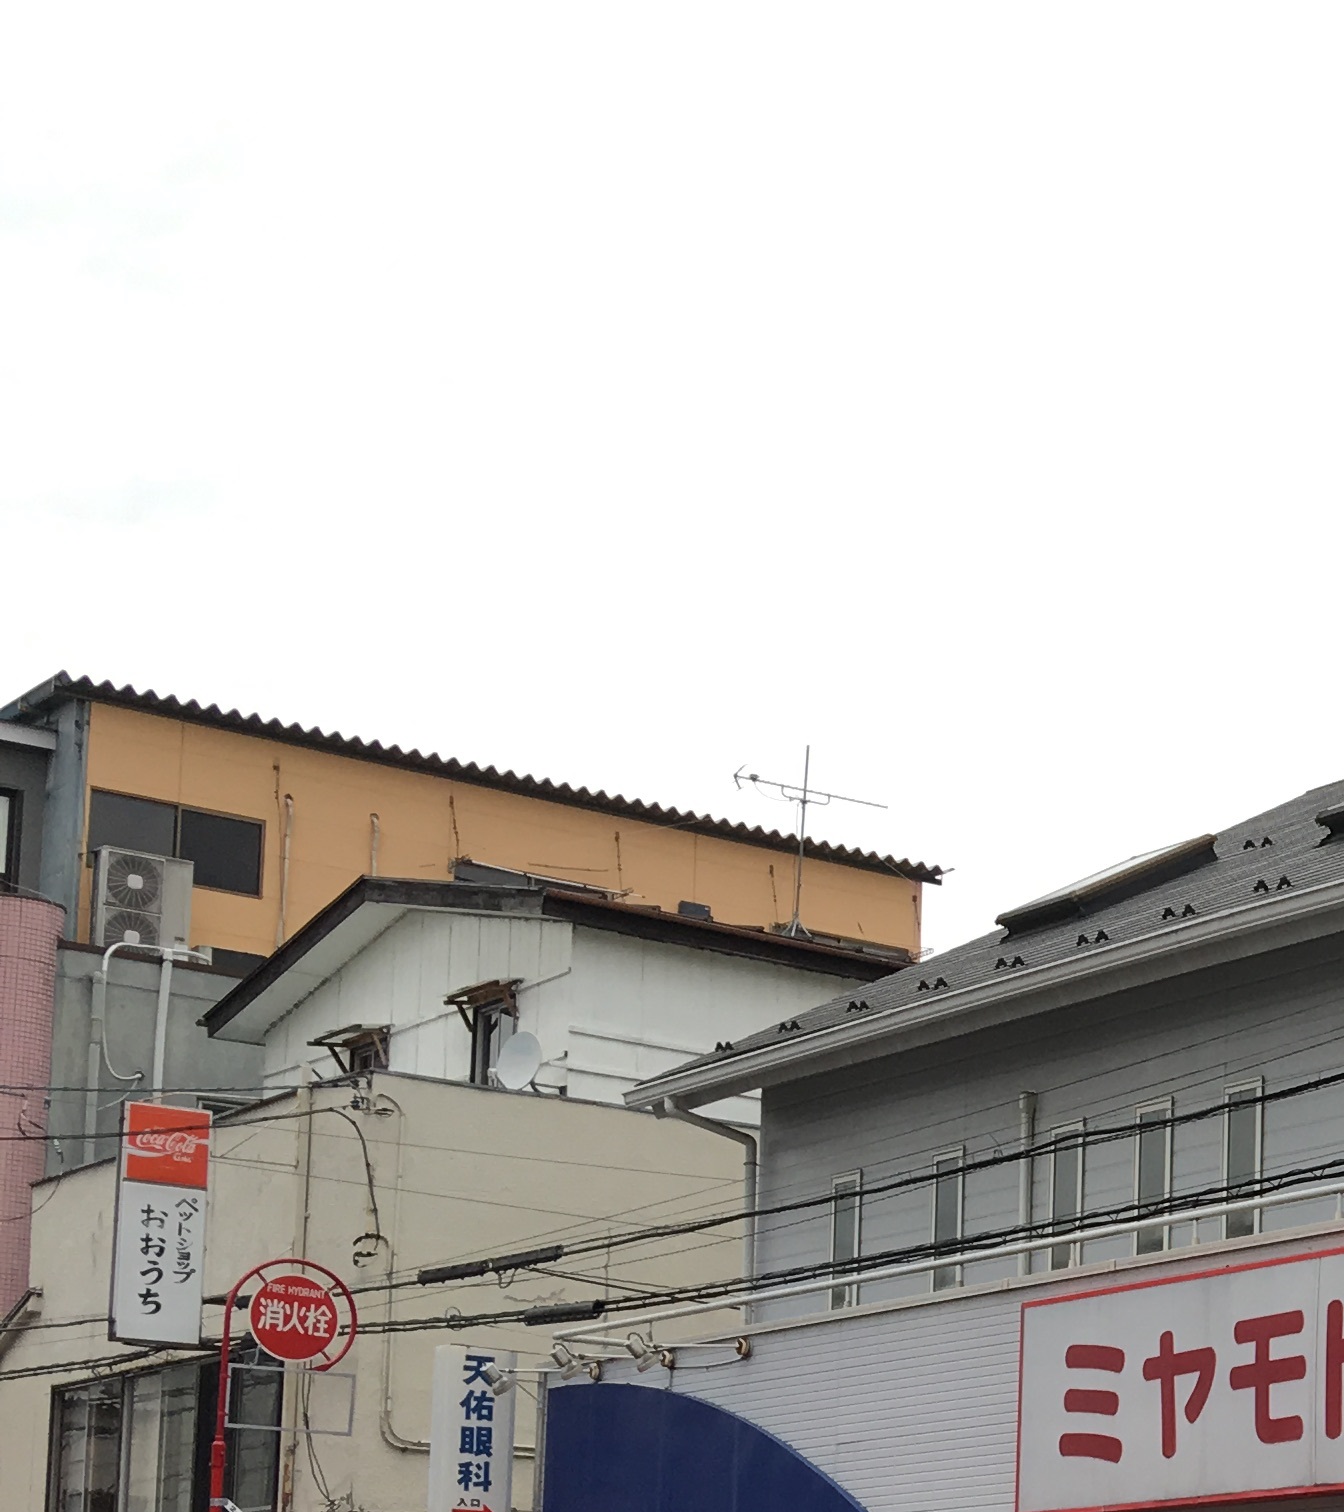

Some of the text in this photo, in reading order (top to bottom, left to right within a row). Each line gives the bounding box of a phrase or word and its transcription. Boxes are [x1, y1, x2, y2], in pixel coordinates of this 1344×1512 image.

[138, 1204, 168, 1316] おおうち
[172, 1197, 199, 1285] ペットショップ
[257, 1297, 333, 1338] 消火栓
[266, 1282, 326, 1300] FIRE HYDRANT
[456, 1354, 496, 1492] 天佑眼科
[457, 1497, 481, 1508] 入口
